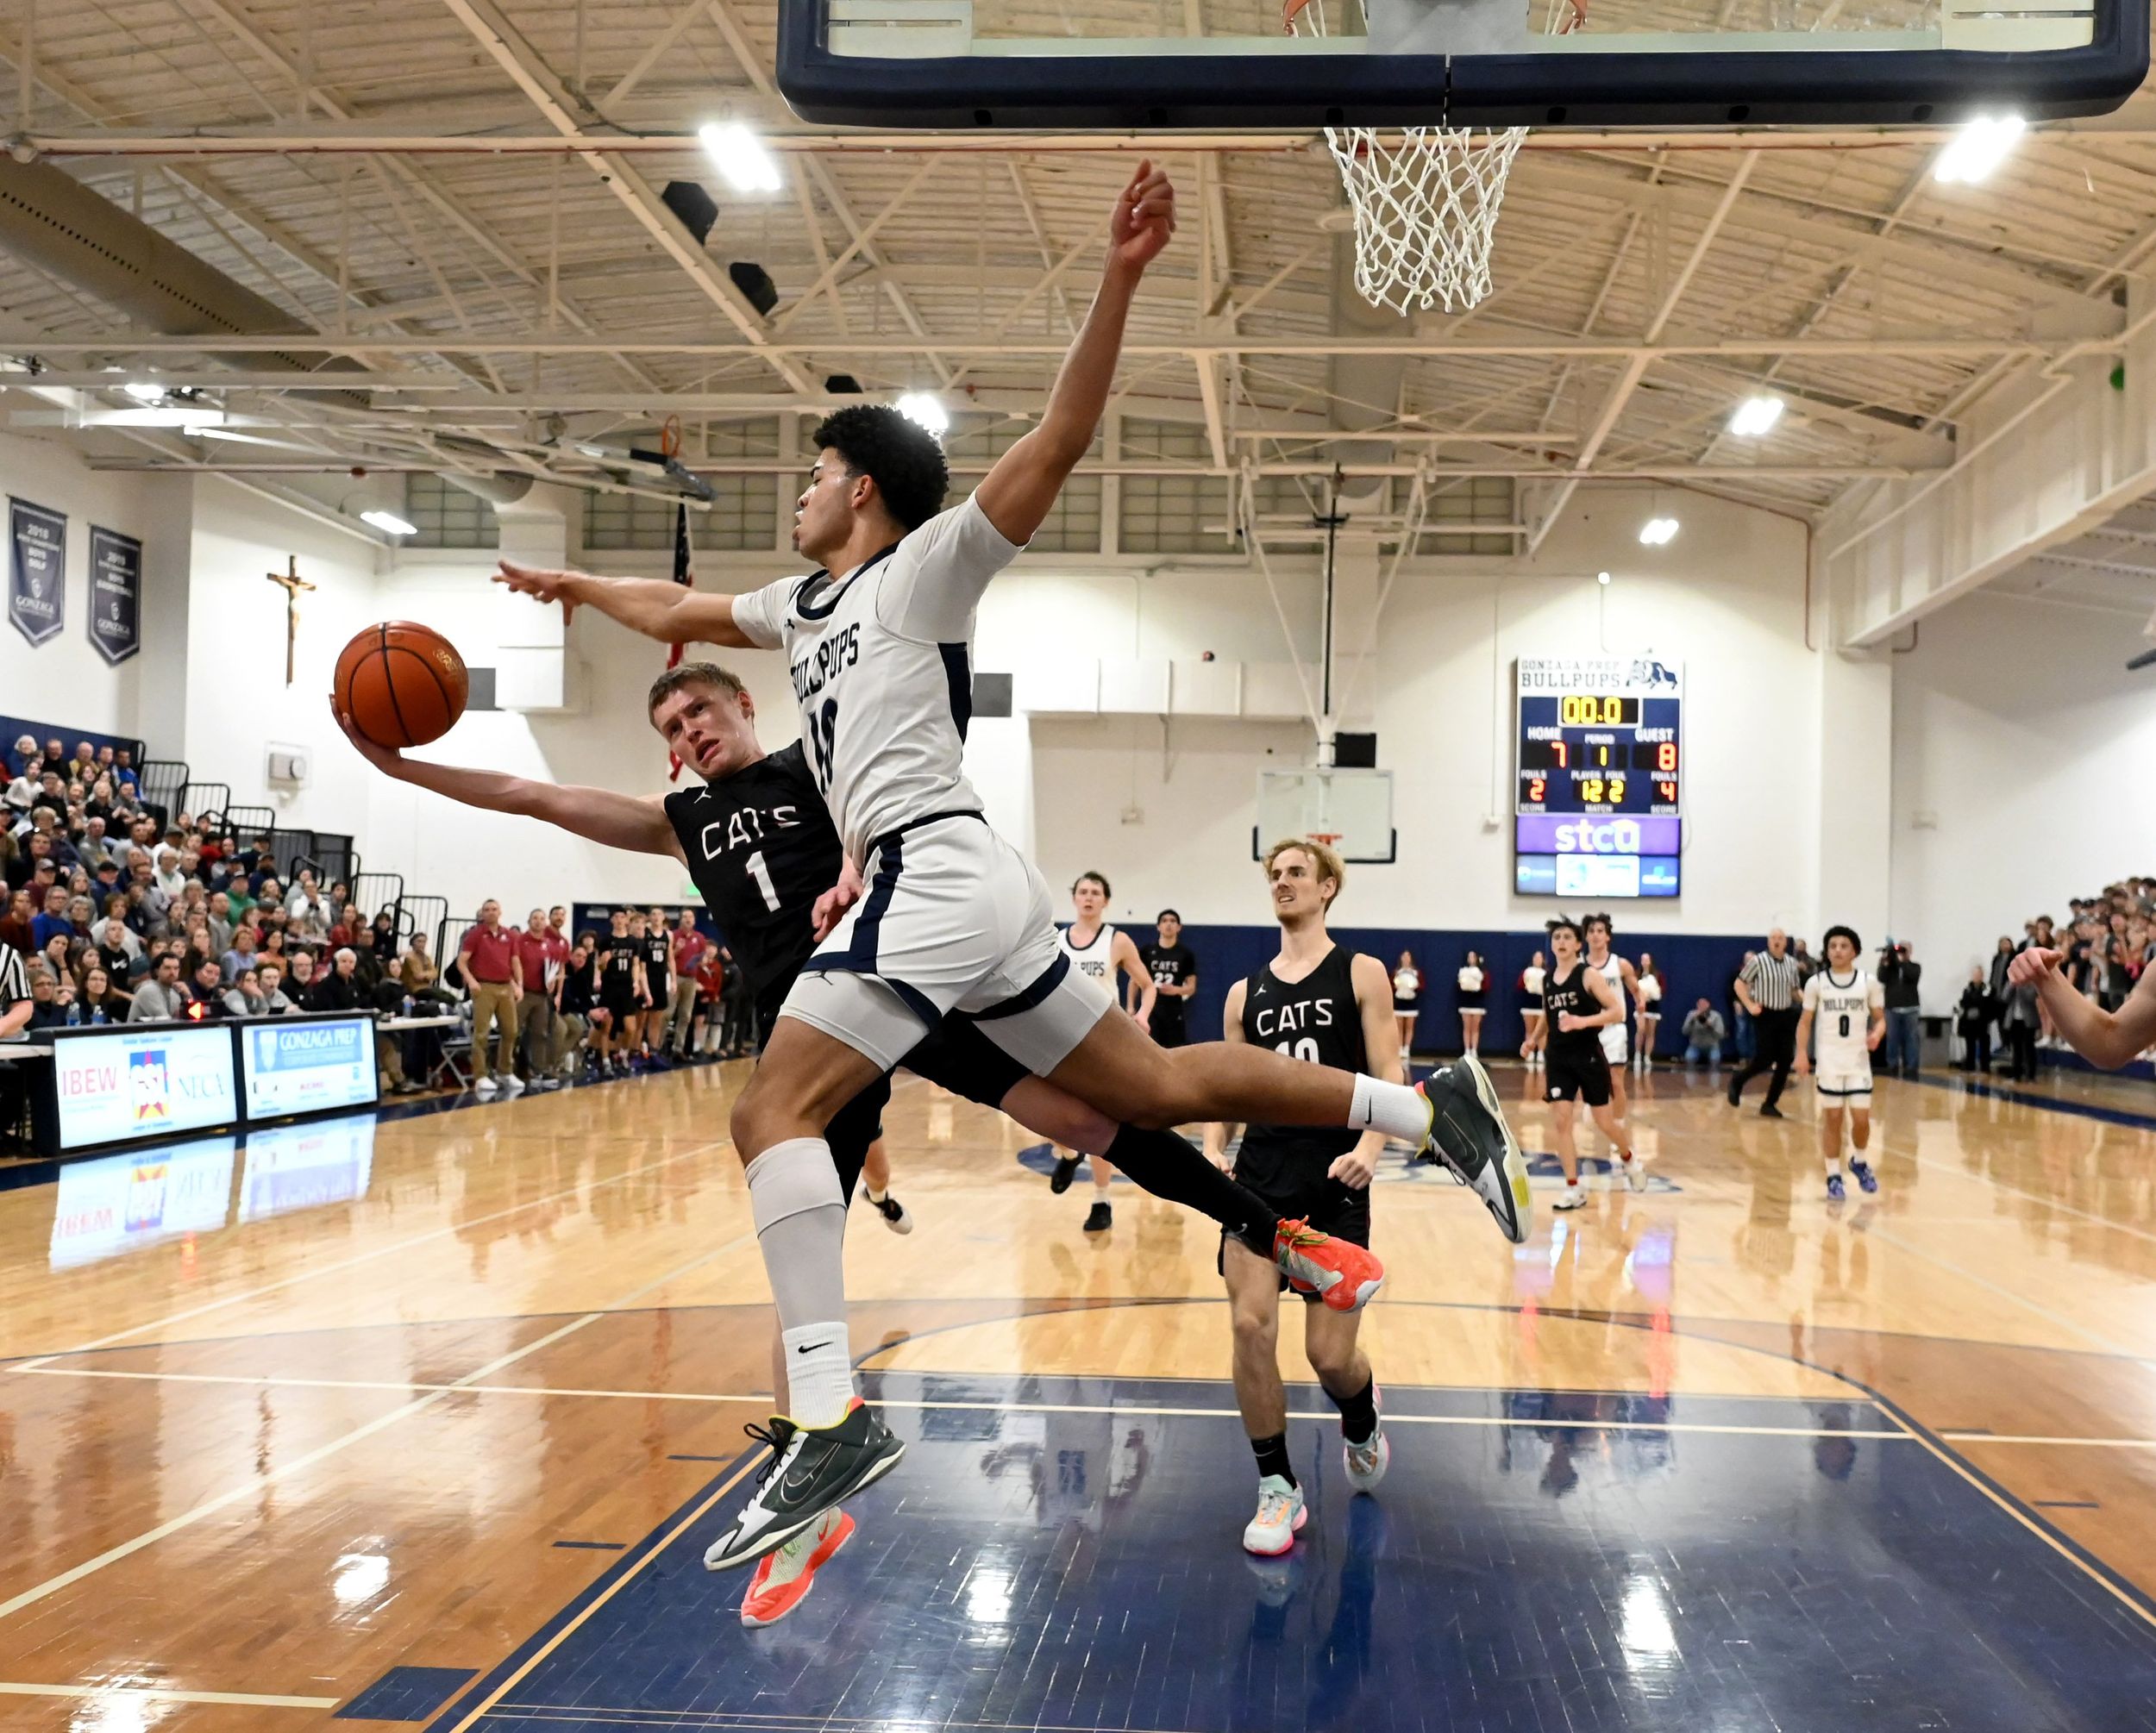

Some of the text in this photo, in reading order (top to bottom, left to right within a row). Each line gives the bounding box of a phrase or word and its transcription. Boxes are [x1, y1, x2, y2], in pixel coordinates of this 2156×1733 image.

[1521, 660, 1620, 670] GONZAGA PREP
[1521, 673, 1620, 687] BULLPUPS
[1563, 696, 1621, 724] 00.0
[1527, 727, 1562, 741] HOME
[1634, 728, 1674, 742] GUEST
[1551, 741, 1566, 768] 7
[1600, 746, 1608, 766] 1
[1658, 742, 1677, 772] 8
[1520, 769, 1547, 779] FOULS
[1570, 770, 1627, 781] PLAYER FOUL
[1651, 771, 1677, 781] FOULS
[1530, 779, 1545, 802] 2
[1582, 779, 1624, 803] 12 2
[1660, 781, 1676, 802] 4
[701, 805, 801, 860] CATS
[745, 850, 781, 913] 1
[1150, 960, 1179, 973] CATS
[1547, 992, 1578, 1010] CATS
[1256, 998, 1333, 1037] CATS
[1839, 1014, 1850, 1038] 0
[279, 1027, 357, 1052] GONZAGA PREP
[62, 1067, 117, 1097] IBEW
[179, 1073, 224, 1099] NECA
